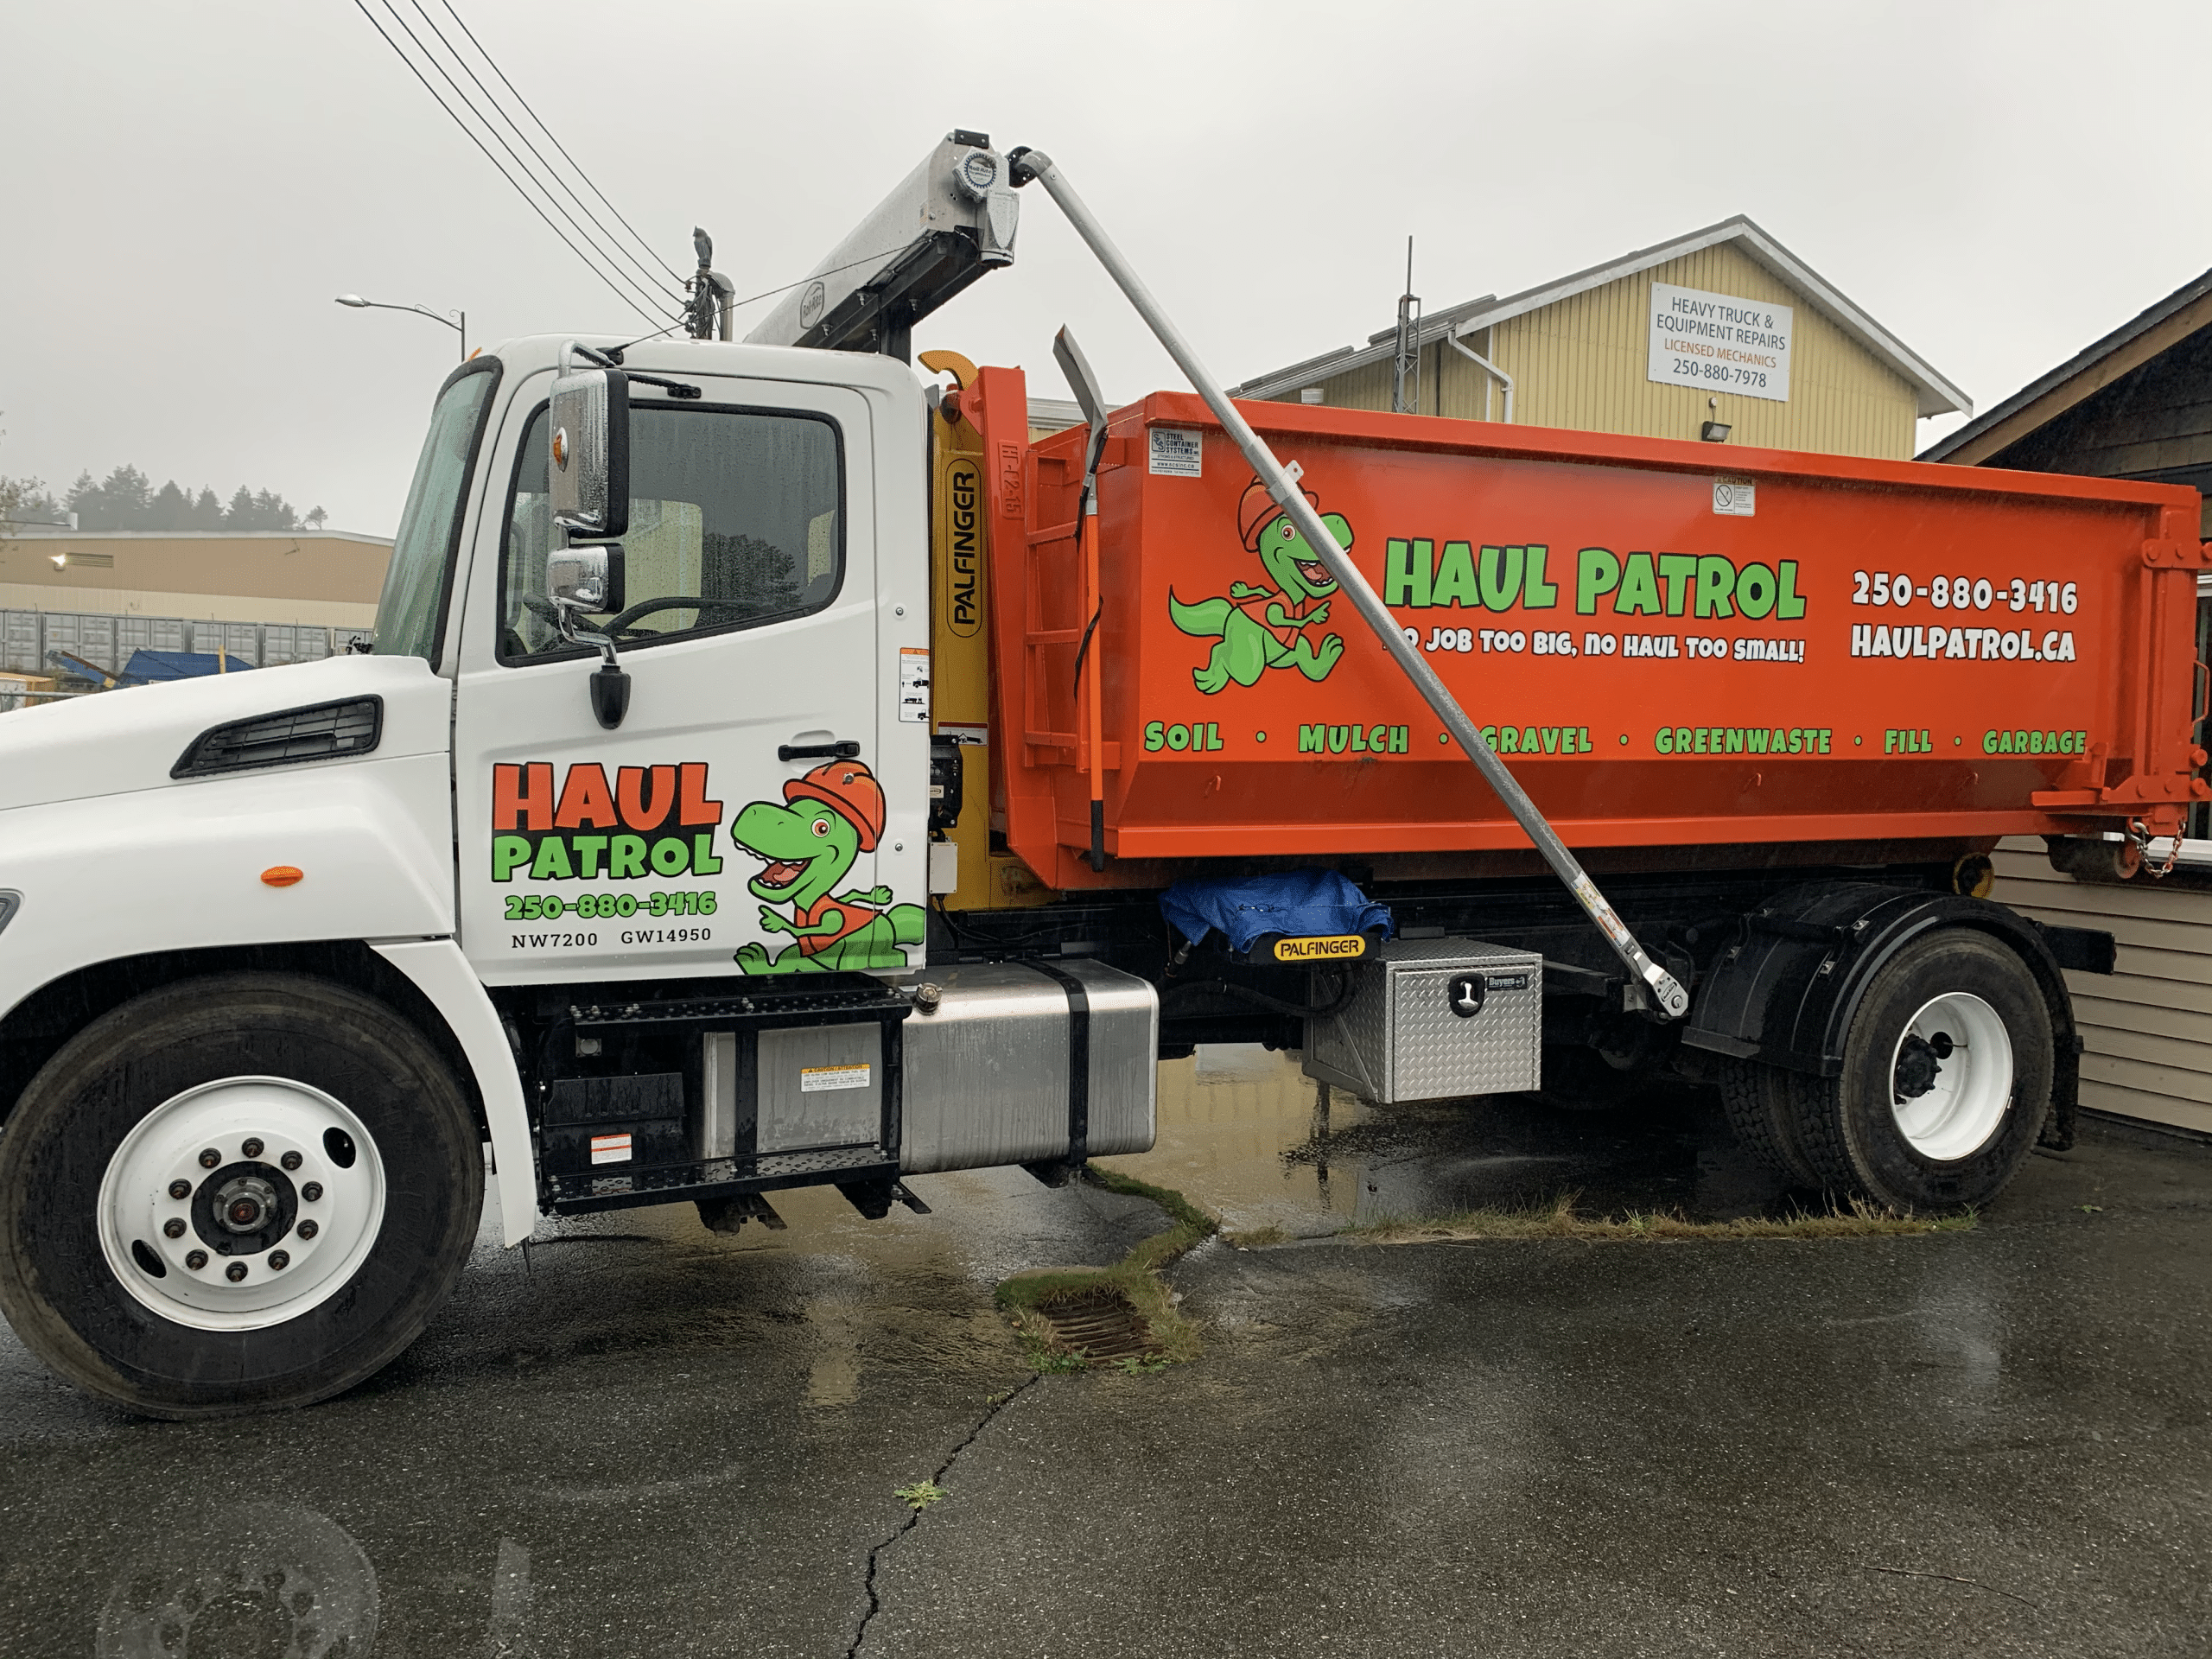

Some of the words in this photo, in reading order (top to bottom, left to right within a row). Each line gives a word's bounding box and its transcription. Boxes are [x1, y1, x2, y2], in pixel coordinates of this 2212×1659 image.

[1672, 296, 1715, 318] HEAVY
[1718, 305, 1760, 327] TRUCK
[1764, 315, 1774, 329] &
[1656, 314, 1733, 340] EQUIPMENT
[1736, 328, 1786, 350] REPAIRS
[1664, 338, 1714, 358] LICENSED
[1717, 347, 1777, 368] MECHANICS
[1673, 358, 1766, 388] 250-880-7978
[1166, 440, 1198, 448] CONTAINER
[953, 470, 976, 626] PALFINGER
[1384, 537, 1558, 613] HAUL
[1576, 547, 1808, 620] PATROL
[1852, 569, 2078, 615] 250-880-3416
[1424, 626, 1474, 653] JOB
[1479, 629, 1527, 653] TOO
[1532, 630, 1578, 658] BIG,
[1623, 634, 1680, 658] HAUL
[1685, 637, 1727, 659] TOO
[1850, 624, 2077, 662] HAULPATROL.CA
[1144, 721, 1224, 752] SOIL
[1298, 723, 1409, 754] MULCH
[1479, 725, 1593, 754] GRAVEL
[1655, 726, 1833, 754] GREENWASTE
[1885, 729, 1933, 753] FILL
[1982, 730, 2088, 756] GARBAGE
[492, 761, 724, 832] HAUL
[491, 833, 723, 883] PATROL
[504, 891, 718, 920] 250-880-3416
[511, 932, 598, 949] NW7200
[620, 927, 712, 944] GW14950
[1280, 938, 1359, 957] PALFINGER
[1489, 977, 1516, 987] Buyers
